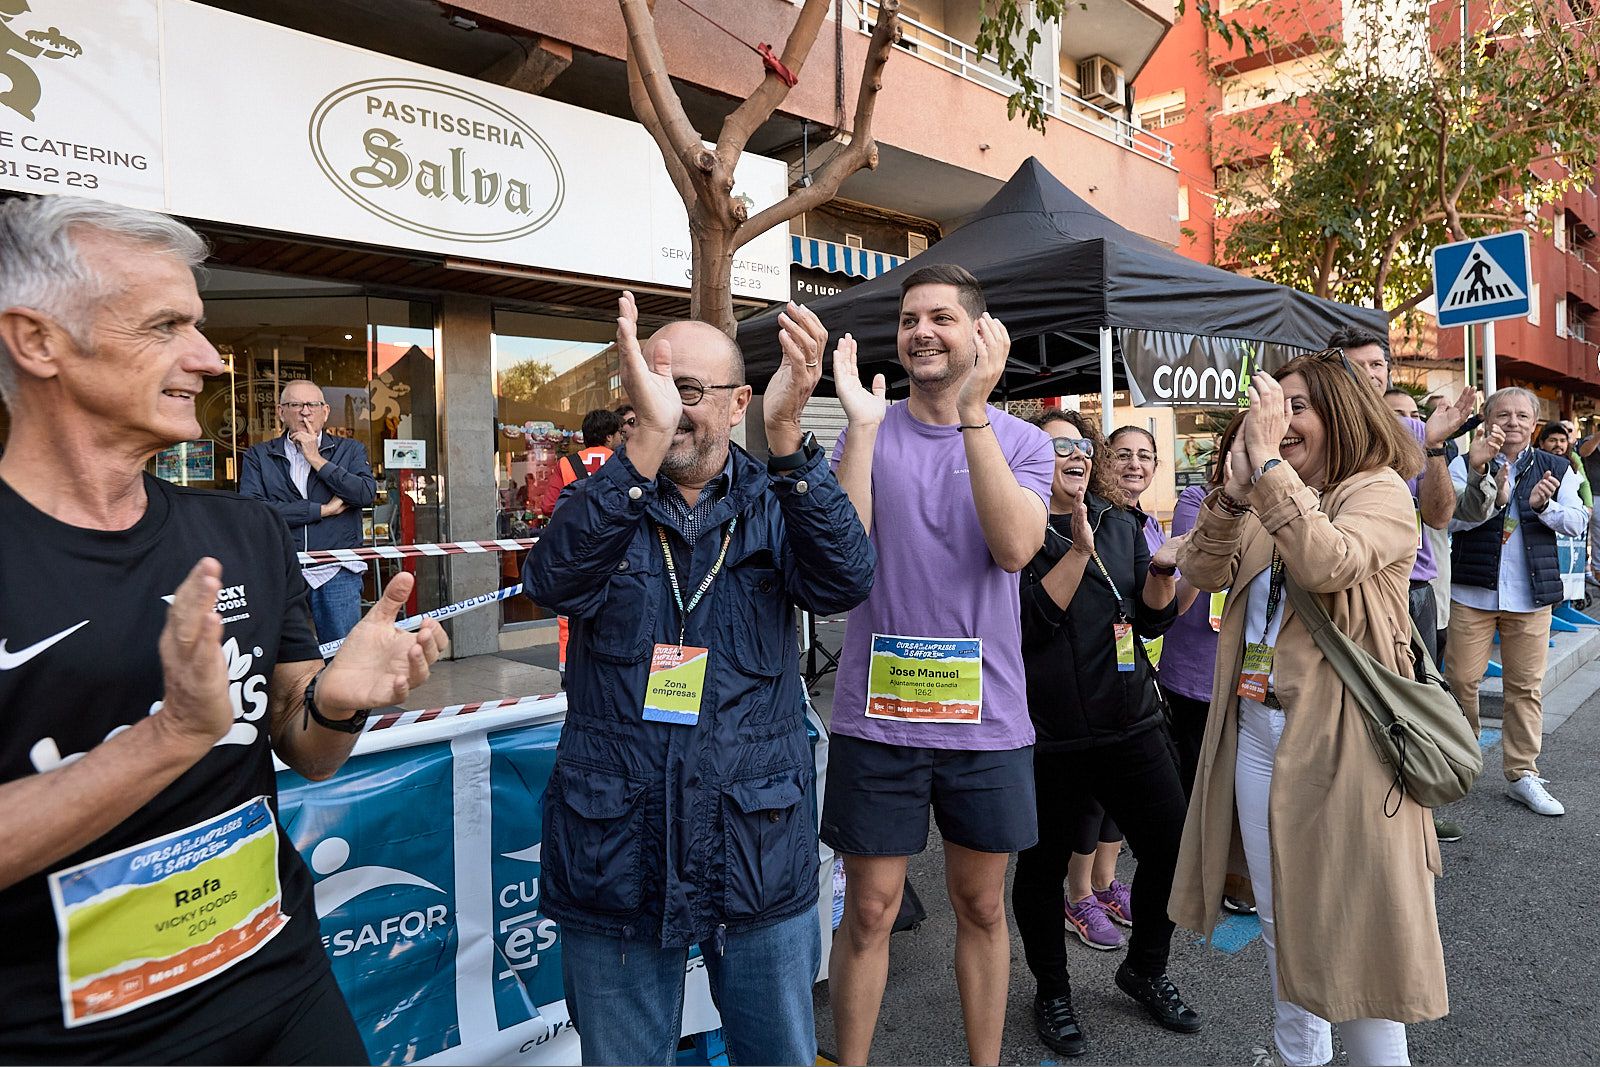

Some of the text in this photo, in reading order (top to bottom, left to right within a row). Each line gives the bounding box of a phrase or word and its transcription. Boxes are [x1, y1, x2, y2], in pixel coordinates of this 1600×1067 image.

[366, 96, 524, 149] PASTISSERIA
[21, 136, 147, 170] CATERING
[26, 164, 59, 183] 52
[66, 171, 99, 189] 23
[350, 127, 533, 216] Salva
[732, 259, 780, 275] CATERING
[733, 277, 761, 289] 52 23
[889, 666, 959, 679] Jose Manuel
[889, 679, 925, 688] Ajuntament
[652, 688, 697, 699] empresas
[664, 680, 687, 689] Zona
[914, 688, 932, 696] 1262
[130, 844, 183, 871] CURSA
[194, 817, 242, 848] EMPRESES
[174, 877, 222, 908] Rafa
[155, 890, 238, 933] VICKY FOODS
[188, 917, 217, 937] 204
[333, 904, 448, 957] SAFOR
